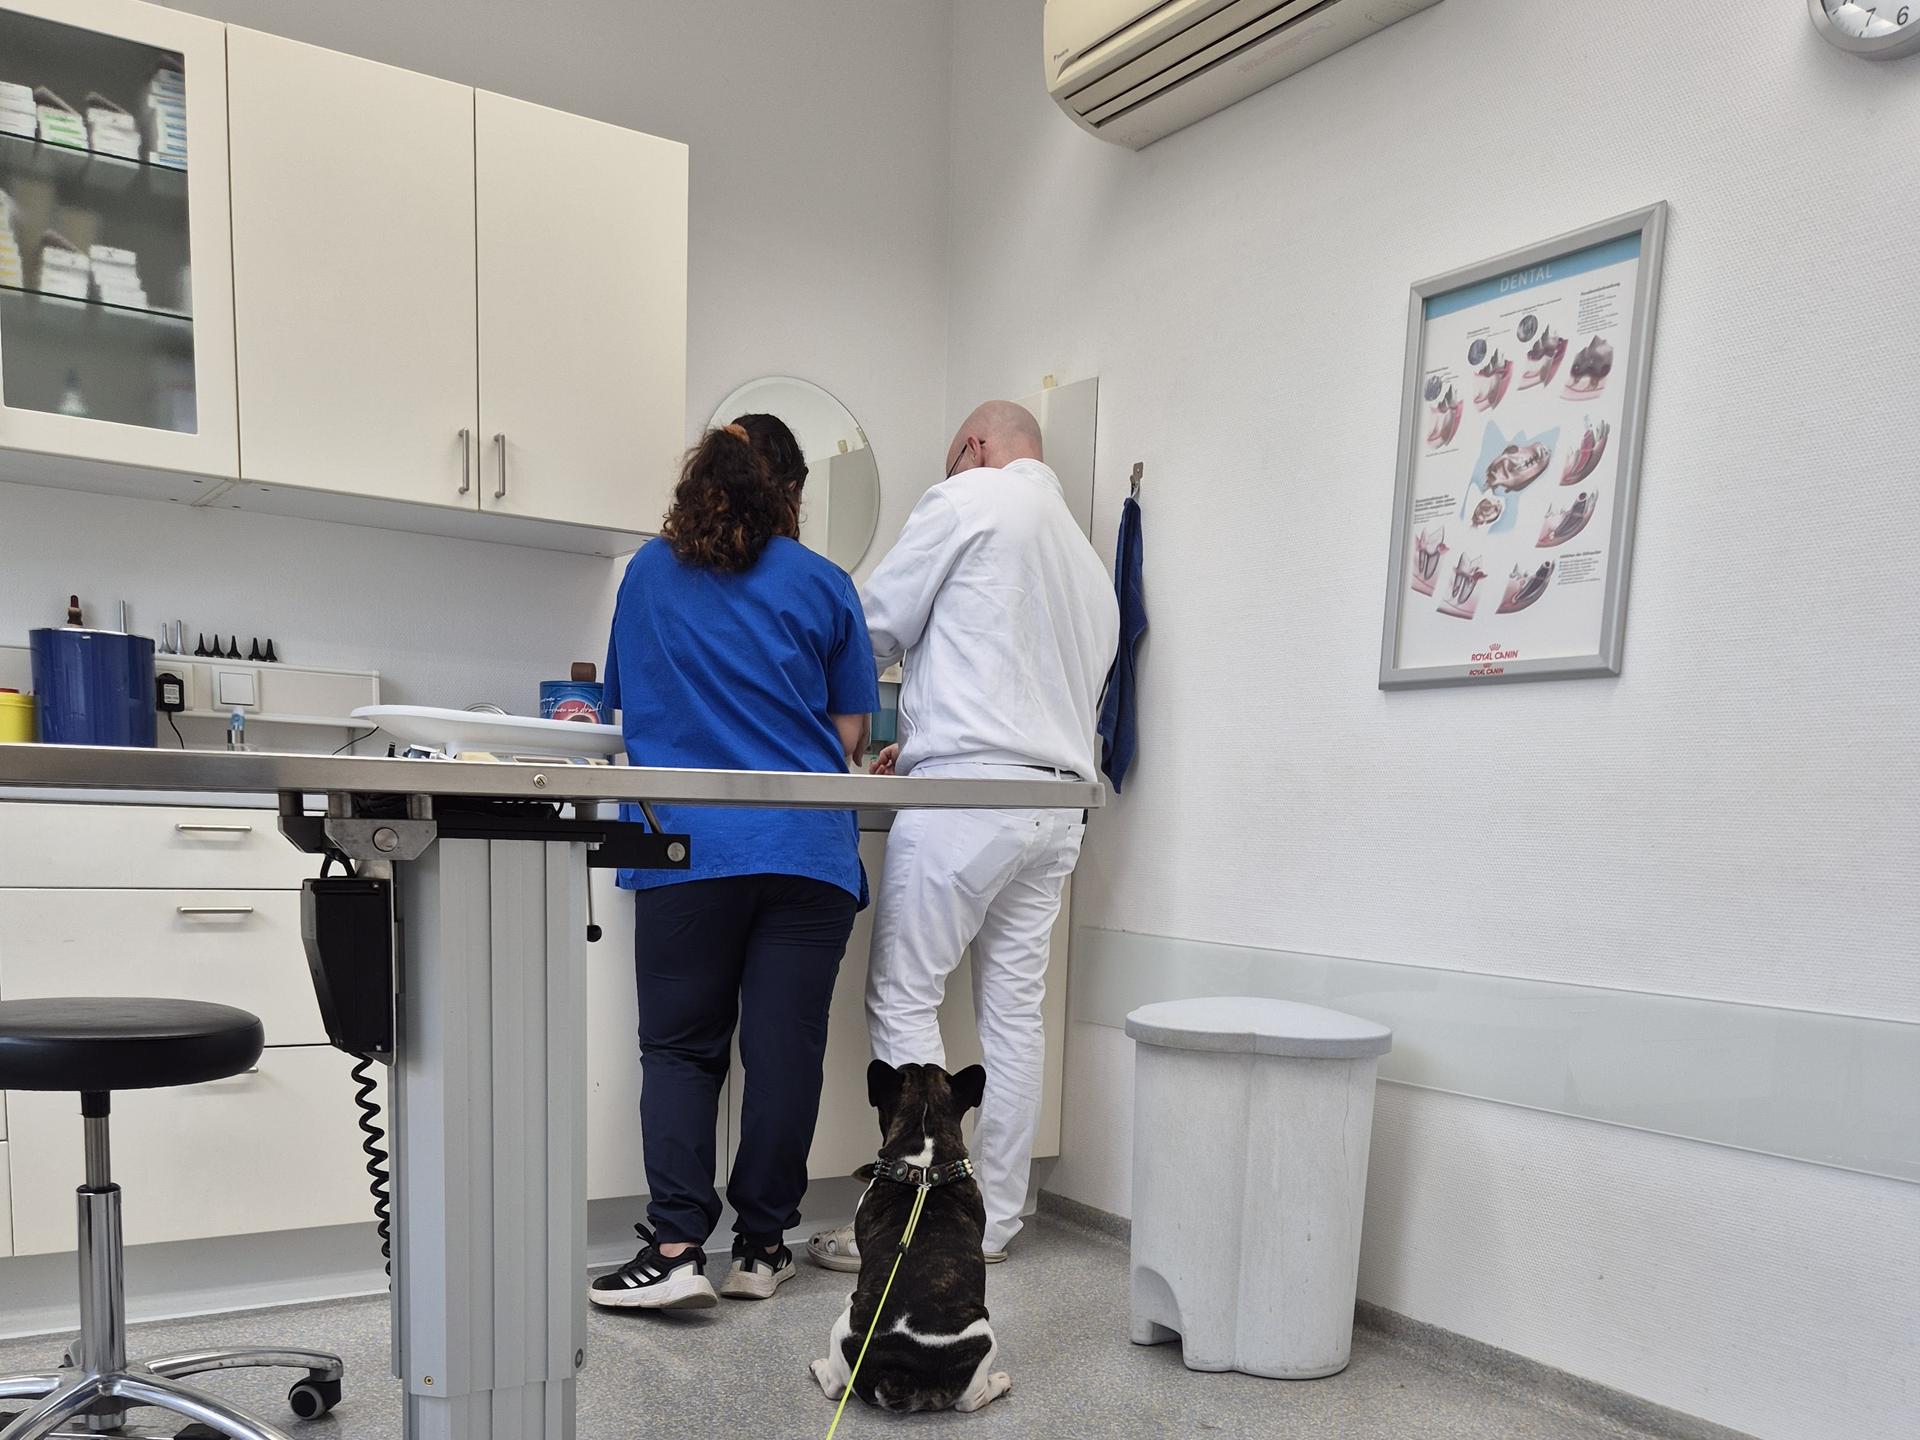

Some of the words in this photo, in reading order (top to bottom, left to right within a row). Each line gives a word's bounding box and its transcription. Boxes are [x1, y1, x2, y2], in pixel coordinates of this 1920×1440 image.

[1866, 7, 1876, 27] 7
[1896, 5, 1910, 26] 6
[1500, 263, 1553, 293] DENTAL
[1471, 652, 1492, 661] ROYAL
[1494, 650, 1518, 659] CANIN
